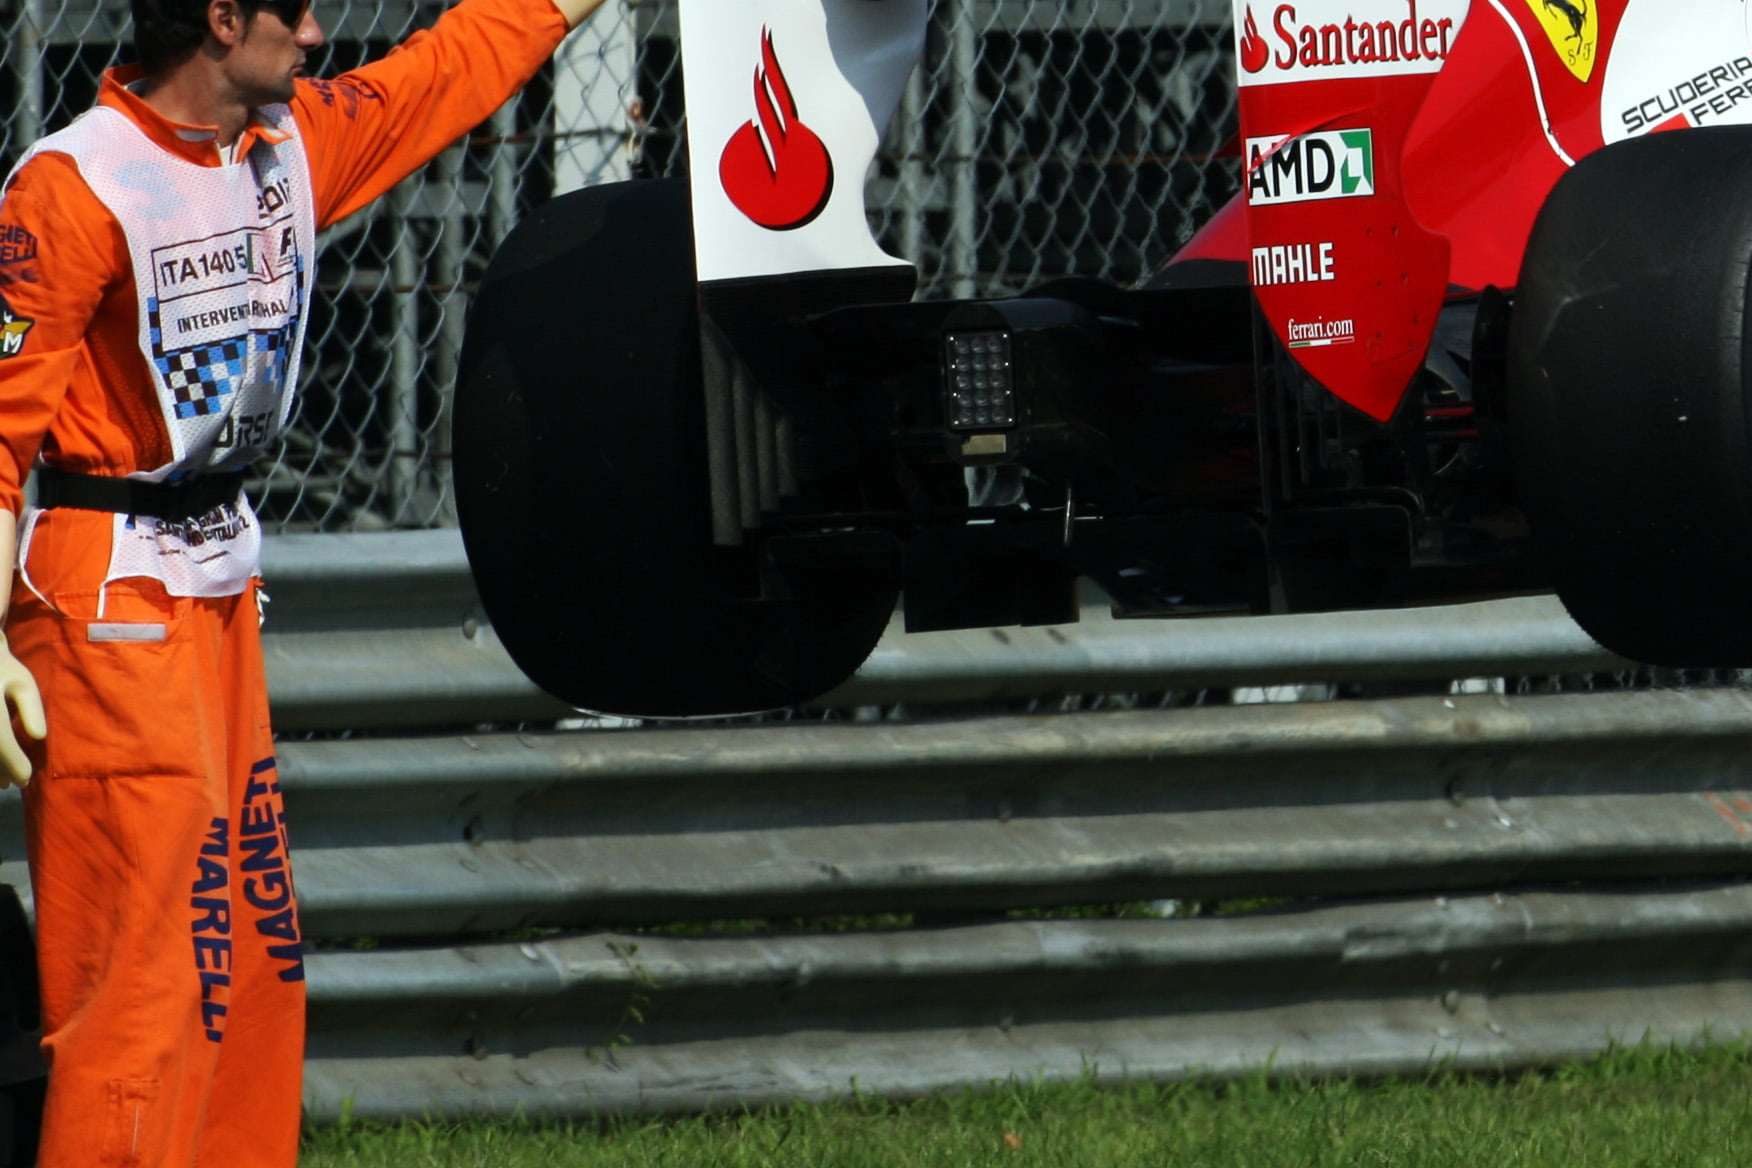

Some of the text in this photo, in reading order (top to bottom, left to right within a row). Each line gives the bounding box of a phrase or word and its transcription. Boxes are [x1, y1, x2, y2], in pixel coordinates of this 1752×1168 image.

[1249, 138, 1336, 200] AMD
[1252, 242, 1336, 287] MAHLE
[1288, 316, 1354, 341] ferrari.com
[238, 756, 305, 983] MAGNETI
[190, 817, 233, 1044] MARELLI
